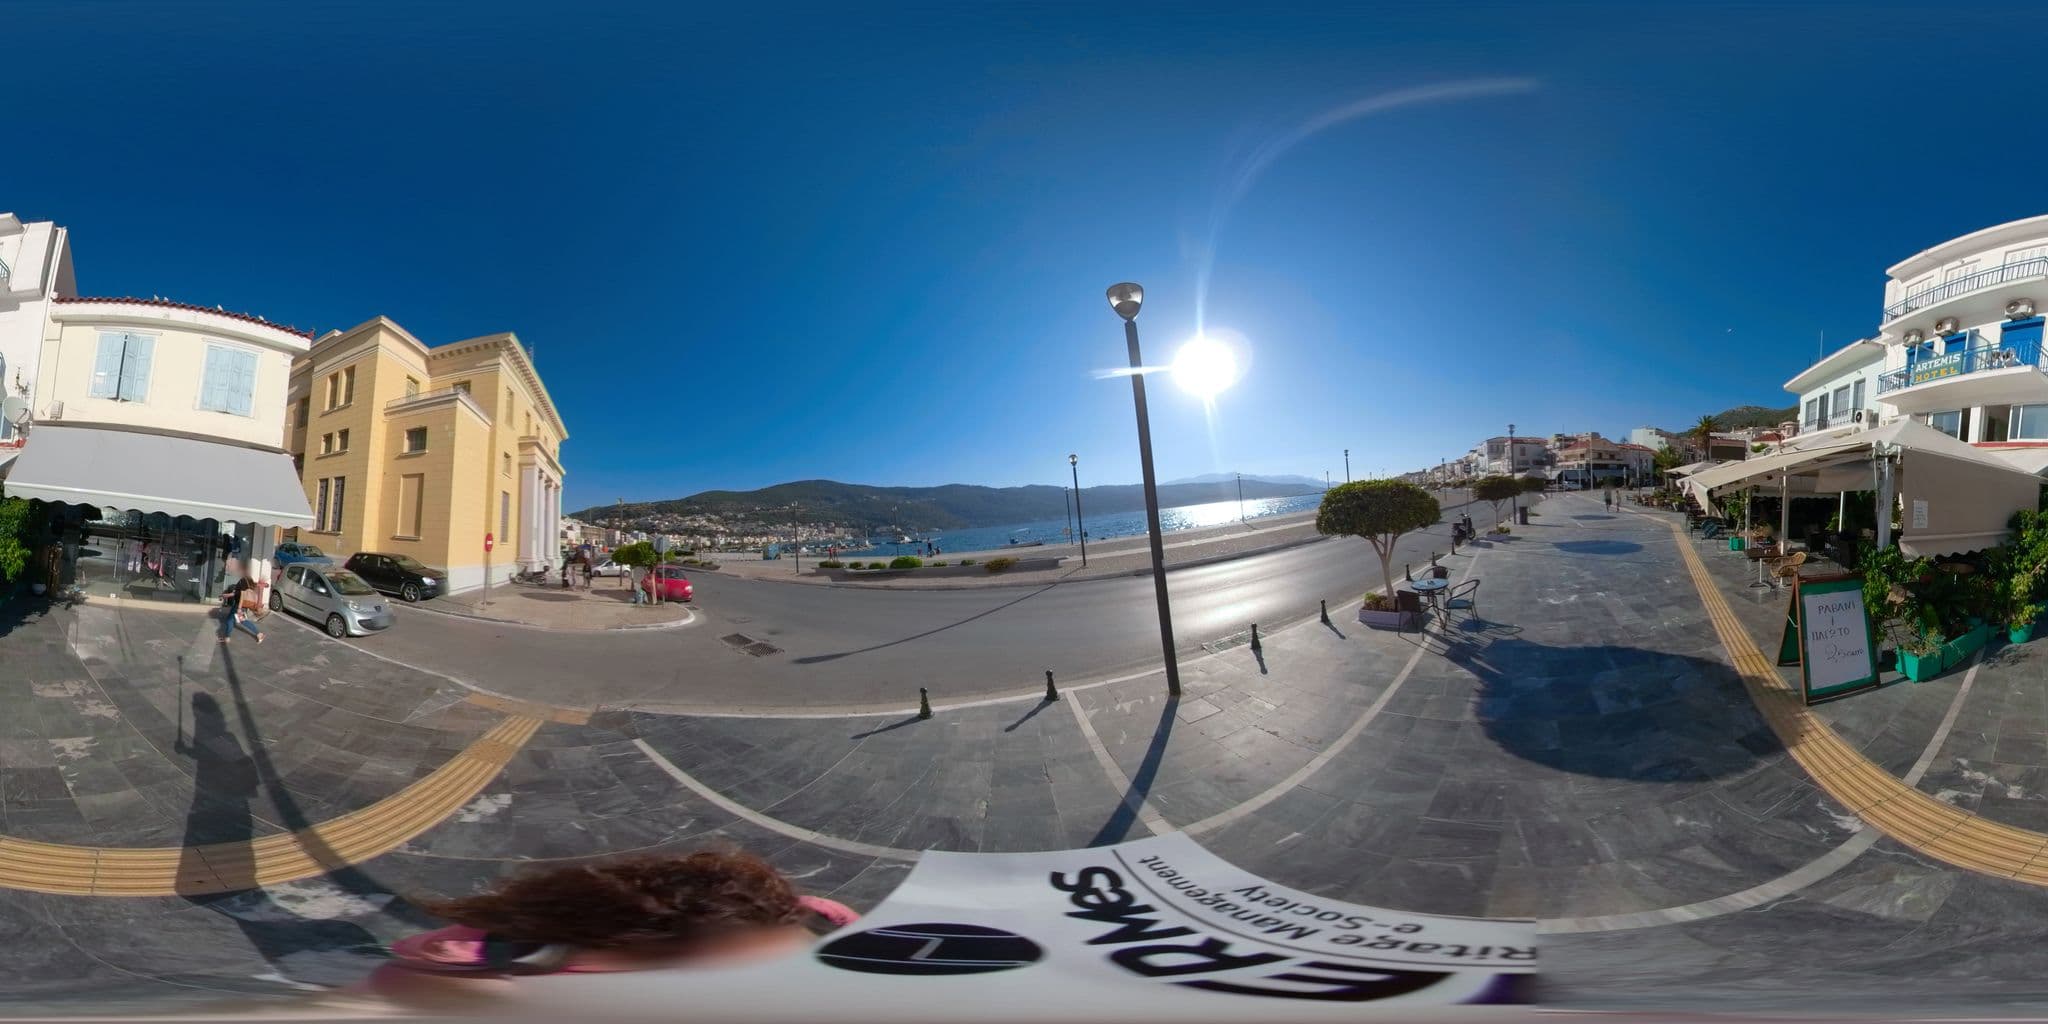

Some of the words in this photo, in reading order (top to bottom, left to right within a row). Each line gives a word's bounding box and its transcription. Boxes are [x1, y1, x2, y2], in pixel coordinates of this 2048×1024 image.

[1915, 353, 1961, 373] ARTEMIS
[1915, 366, 1958, 382] HOTEL
[1138, 855, 1323, 940] Management
[1234, 885, 1424, 934] e-Society
